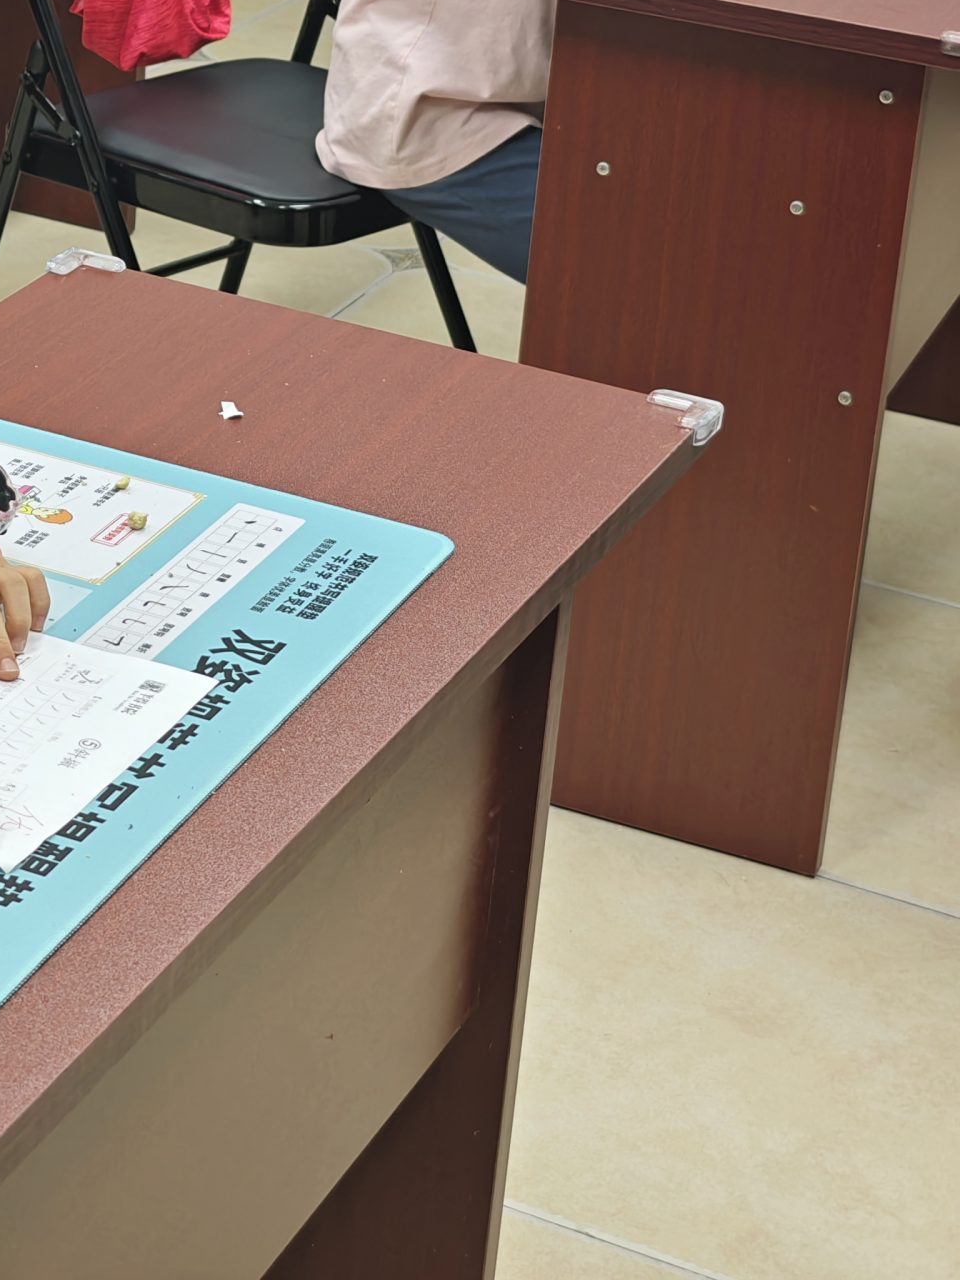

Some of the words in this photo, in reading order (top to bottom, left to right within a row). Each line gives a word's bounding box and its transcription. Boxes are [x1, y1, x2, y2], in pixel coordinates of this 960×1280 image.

[311, 547, 357, 580] 一手好字
[274, 580, 323, 615] 终身受益
